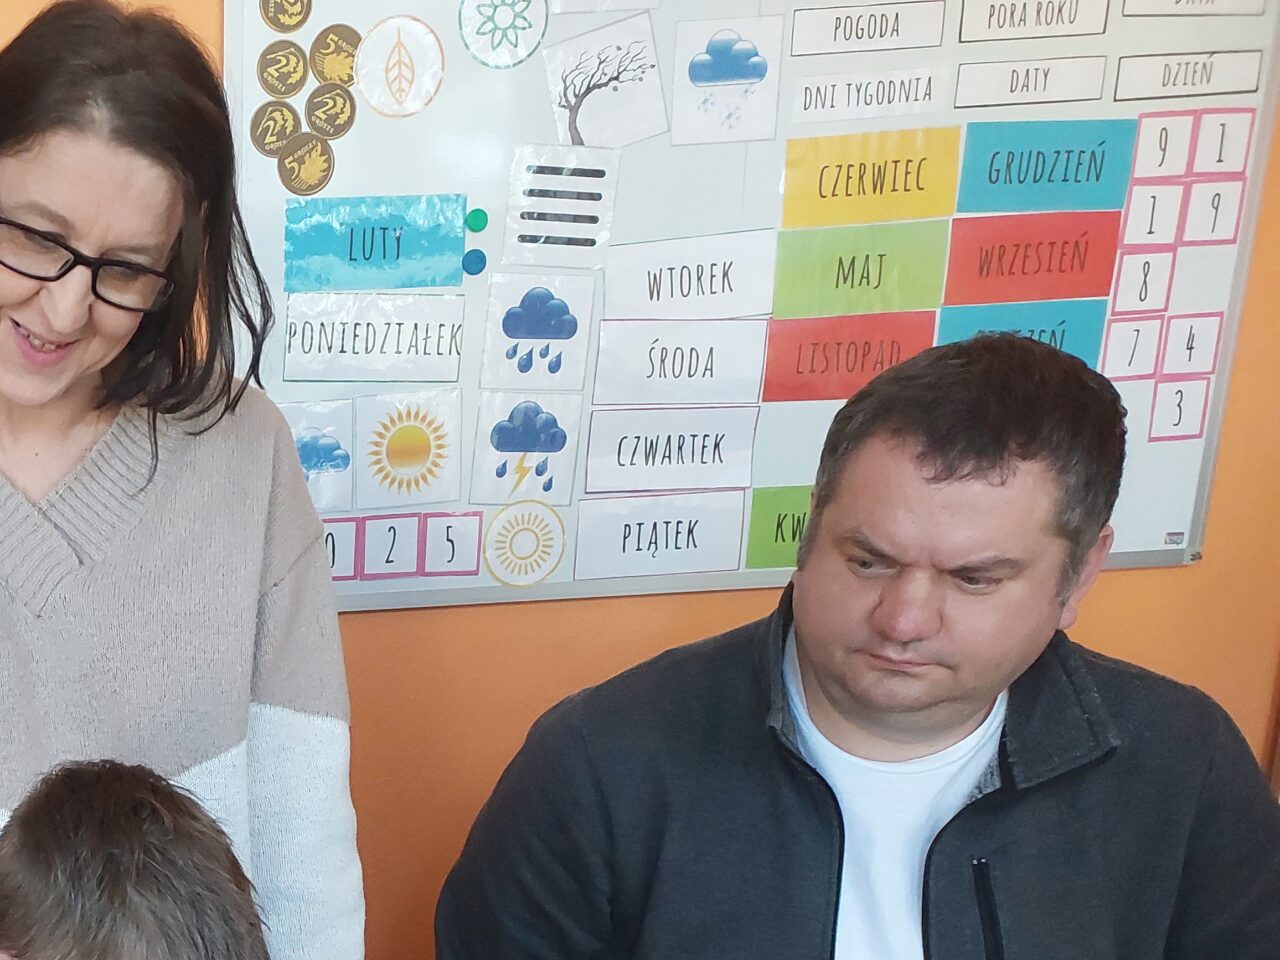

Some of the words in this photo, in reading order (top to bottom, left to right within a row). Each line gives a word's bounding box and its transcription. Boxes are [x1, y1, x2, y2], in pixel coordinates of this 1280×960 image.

[833, 12, 901, 41] POGODA
[987, 3, 1027, 30] PORA
[1035, 0, 1079, 27] ROKU
[1009, 67, 1051, 93] DATY
[1161, 52, 1216, 87] DZIEŃ
[803, 84, 838, 112] DNI
[844, 75, 933, 109] TYGODNIA
[988, 140, 1107, 185] GRUDZIEŃ
[1158, 127, 1168, 167] 9
[1216, 123, 1226, 163] 1
[818, 157, 928, 199] CZERWIEC
[1147, 195, 1157, 235] 1
[1211, 193, 1221, 234] 9
[348, 226, 403, 262] LUTY
[978, 231, 1089, 279] WRZESIEŃ
[647, 260, 735, 302] WTOREK
[835, 253, 887, 289] MAJ
[1139, 261, 1150, 302] 8
[287, 320, 463, 356] PONIEDZIAŁEK
[796, 339, 901, 375] LISTOPAD
[1128, 329, 1140, 367] 7
[1186, 324, 1195, 362] 4
[646, 338, 714, 379] ŚRODA
[1173, 389, 1183, 427] 3
[617, 433, 726, 467] CZWARTEK
[385, 526, 397, 564] 2
[446, 525, 456, 563] 5
[622, 519, 700, 558] PIĄTEK
